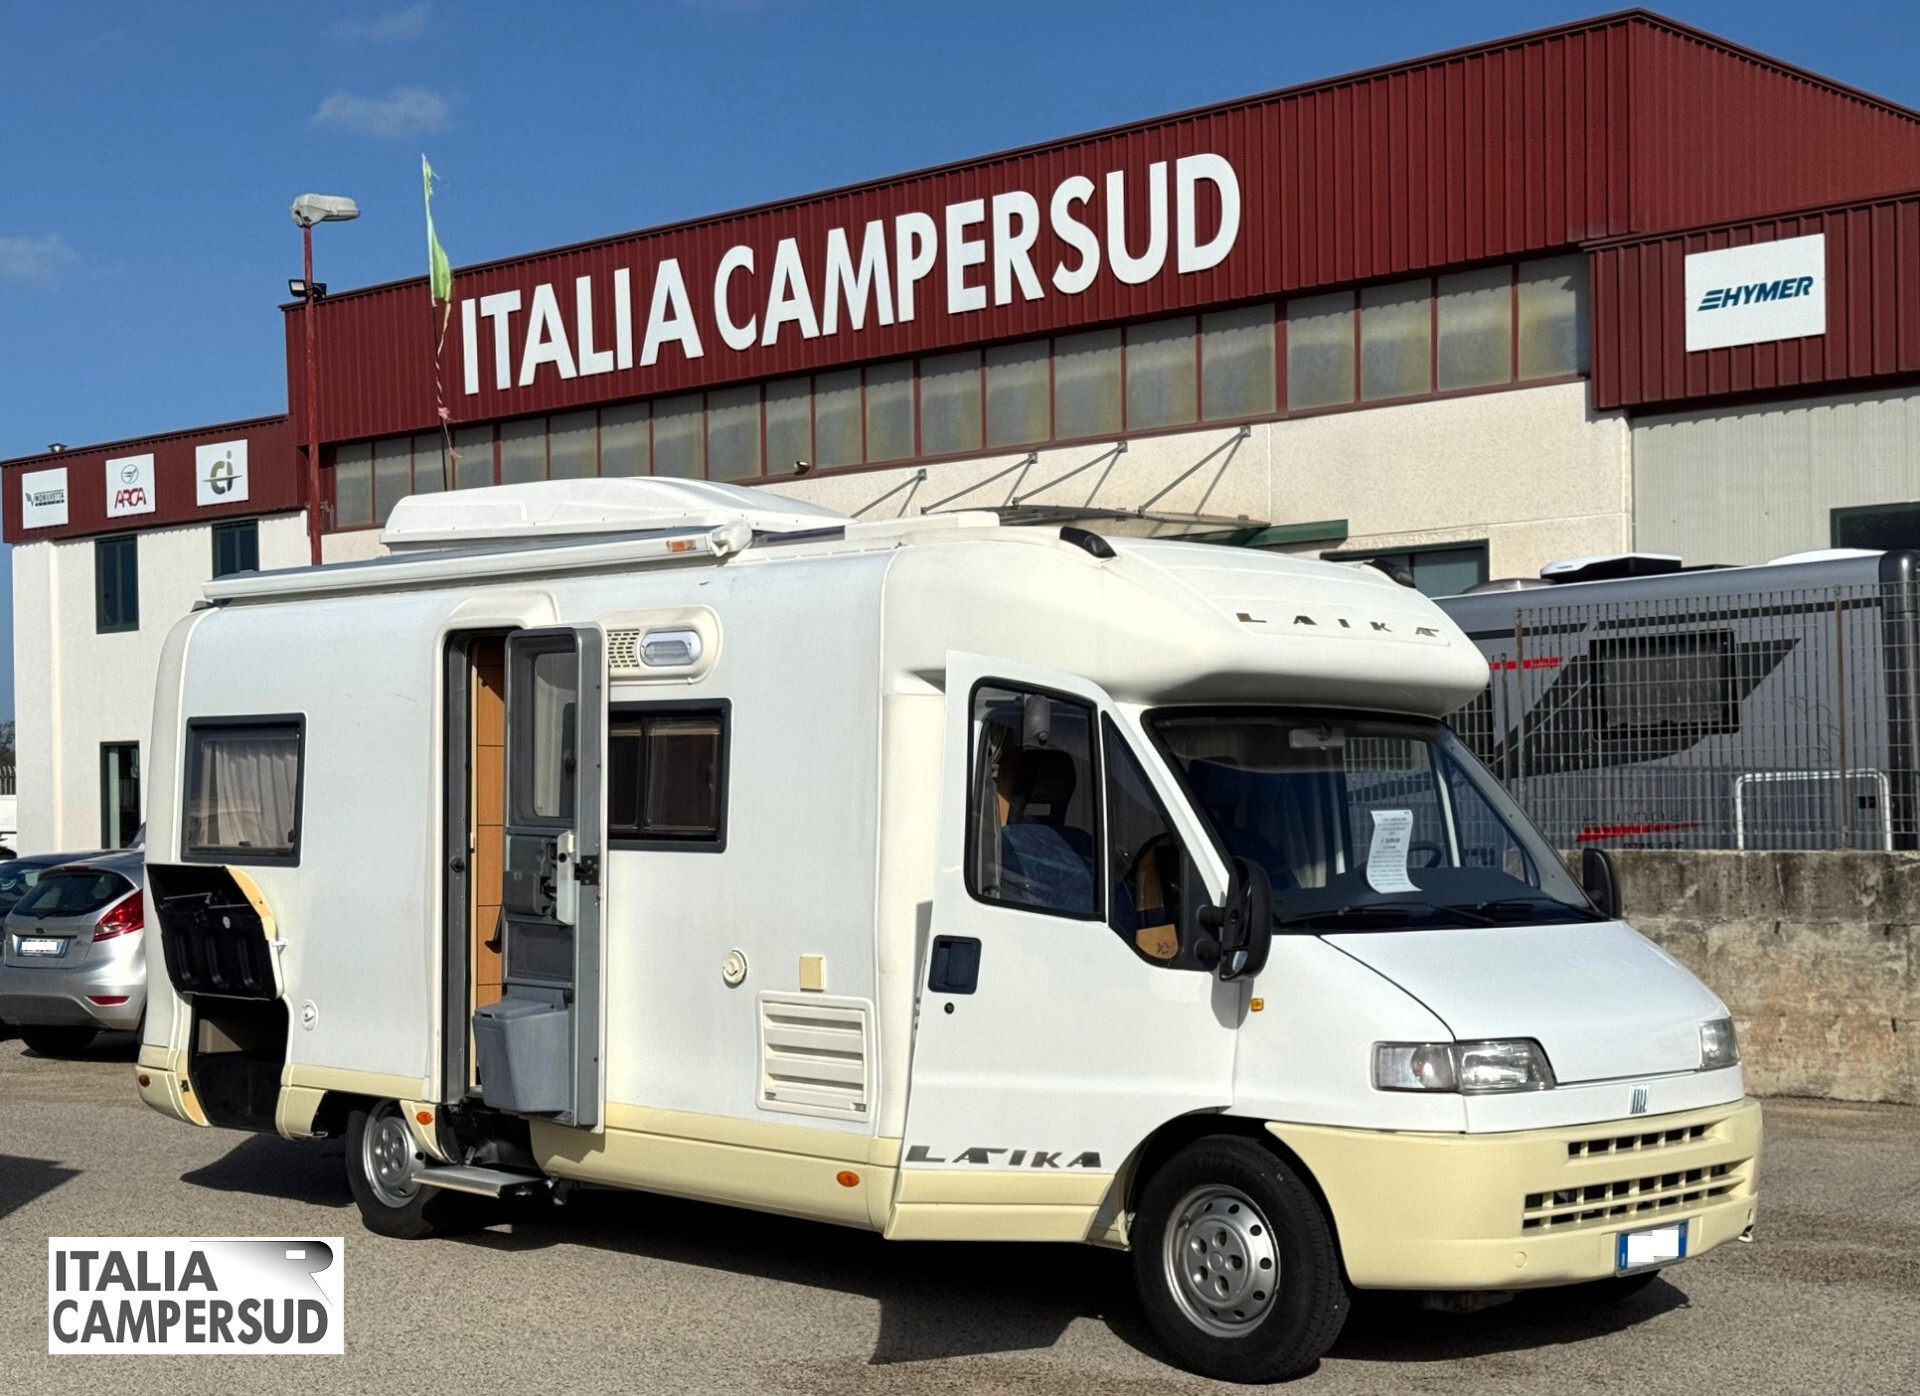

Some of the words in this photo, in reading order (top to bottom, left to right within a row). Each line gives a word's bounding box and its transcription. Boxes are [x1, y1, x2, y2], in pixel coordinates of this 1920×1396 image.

[461, 258, 704, 395] ITALIA
[713, 153, 1241, 352] CAMPERSUD
[1721, 275, 1814, 308] HYMER
[115, 487, 146, 509] ARCA
[1236, 612, 1440, 638] LAIKA
[905, 1145, 1102, 1169] LAIKA
